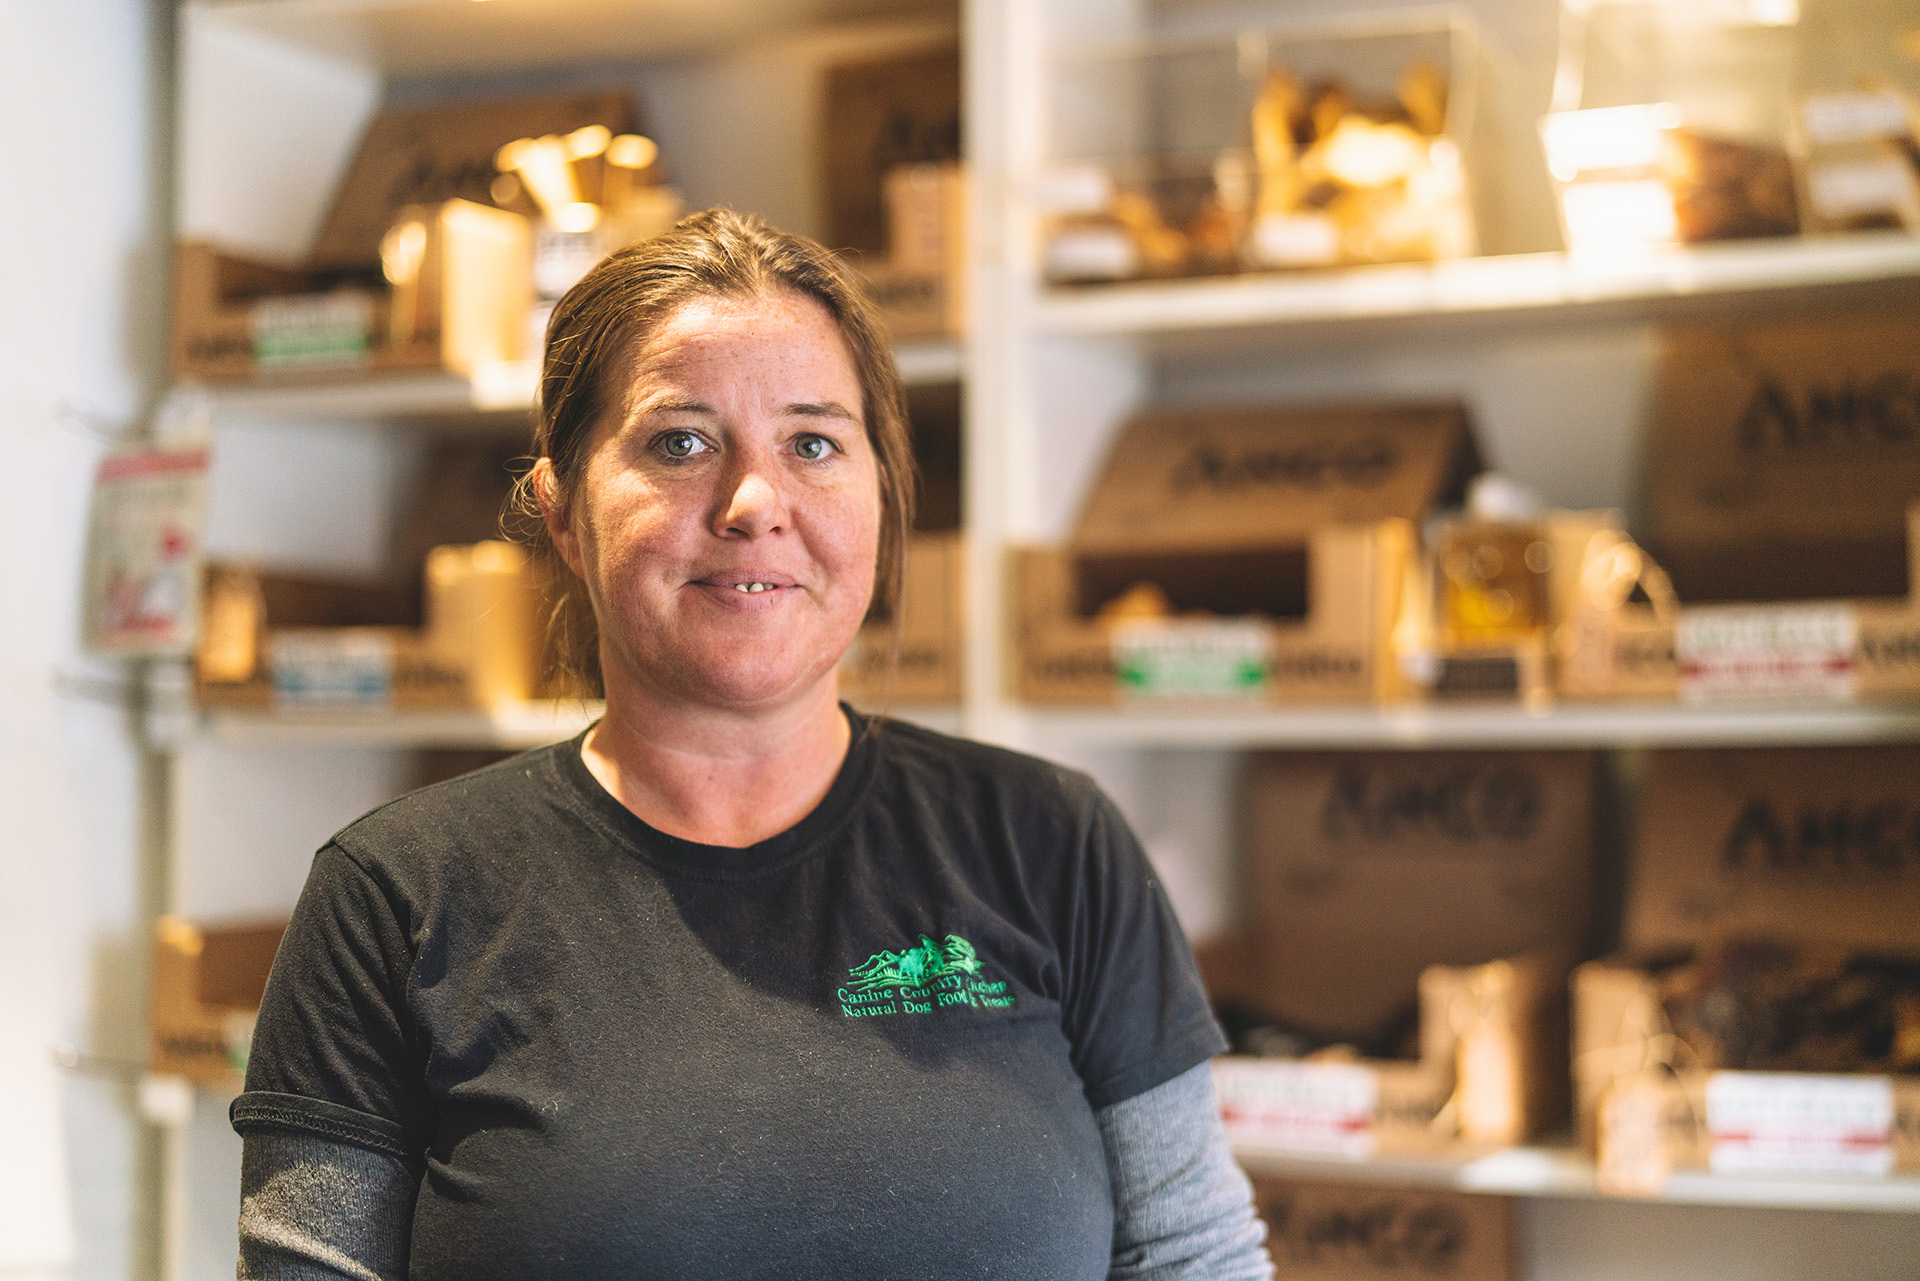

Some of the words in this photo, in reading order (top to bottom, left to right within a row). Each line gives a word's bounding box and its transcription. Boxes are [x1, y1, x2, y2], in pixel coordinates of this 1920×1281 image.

[837, 988, 893, 1004] Canine
[899, 975, 961, 999] Country
[841, 1000, 897, 1017] Natural
[902, 1001, 933, 1015] Dog
[937, 989, 968, 1007] Food
